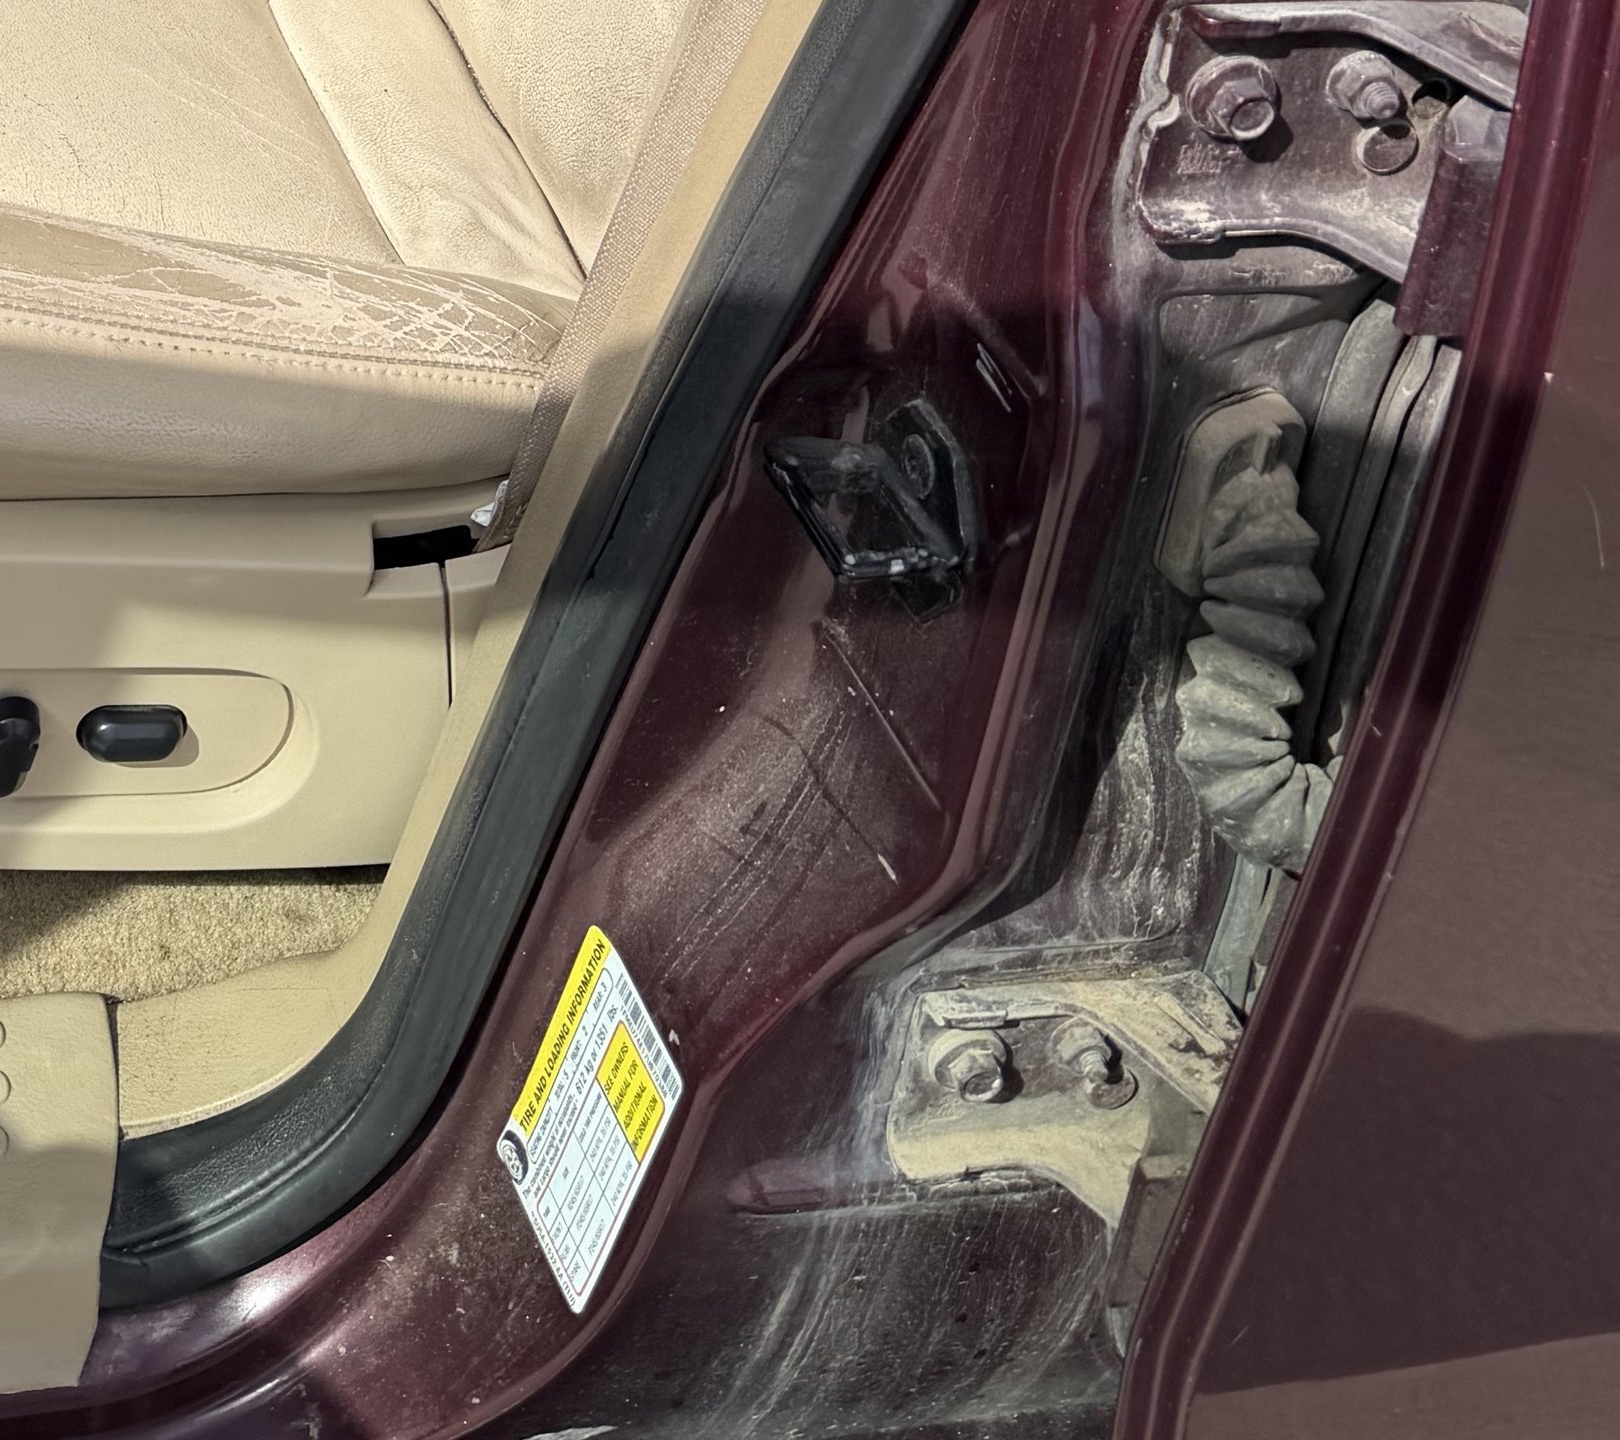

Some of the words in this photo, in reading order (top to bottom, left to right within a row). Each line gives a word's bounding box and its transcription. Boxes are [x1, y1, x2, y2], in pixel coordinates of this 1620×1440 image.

[601, 981, 607, 992] 3
[519, 1101, 536, 1131] TIRE
[534, 1076, 546, 1104] AND
[544, 1023, 569, 1077] LOADING
[567, 939, 605, 1024] INFORMATION
[582, 1025, 588, 1036] 2
[563, 1069, 569, 1080] 5
[575, 1071, 587, 1095] 612
[584, 1059, 594, 1075] kg
[591, 1048, 597, 1062] or
[595, 1023, 608, 1050] 1351
[604, 1075, 614, 1095] SEE
[613, 1078, 631, 1113] MANUAL
[627, 1060, 638, 1080] FOR
[623, 1082, 646, 1130] ADDITIONAL
[631, 1095, 657, 1151] INFORMATION
[522, 1186, 531, 1199] The
